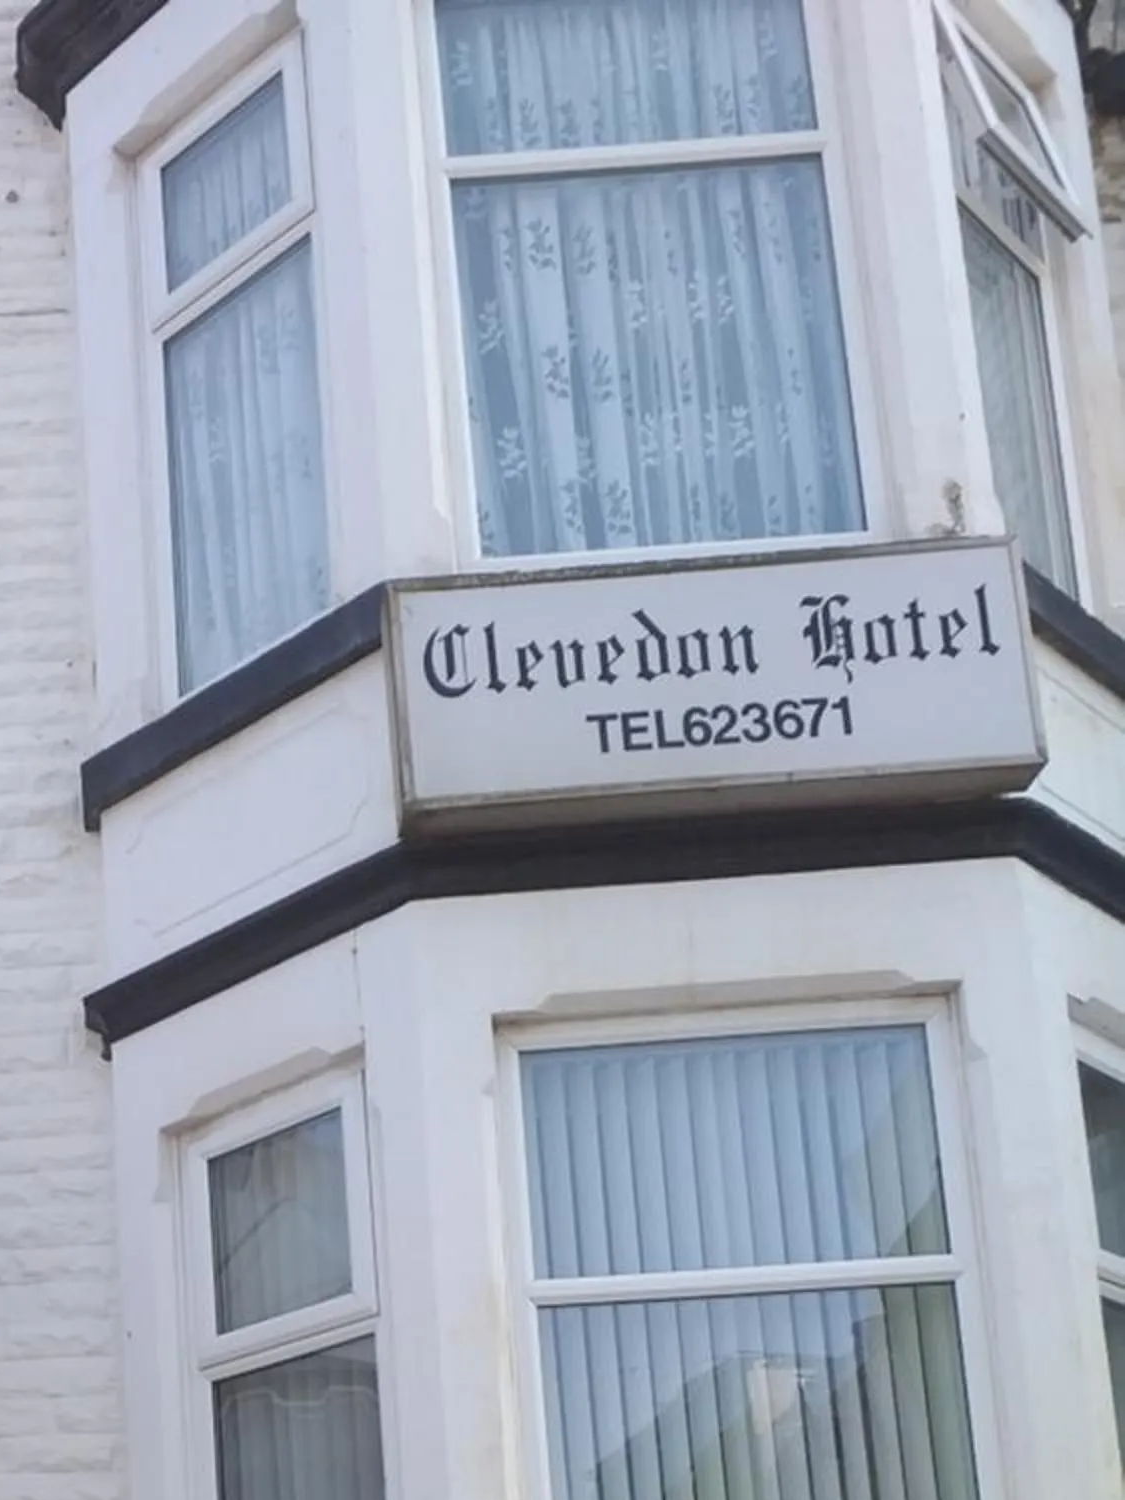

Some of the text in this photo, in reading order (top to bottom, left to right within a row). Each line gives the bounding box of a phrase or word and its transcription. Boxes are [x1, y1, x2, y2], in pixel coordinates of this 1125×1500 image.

[423, 583, 1001, 699] Clevedon Hotel
[586, 696, 853, 754] TEL623671
